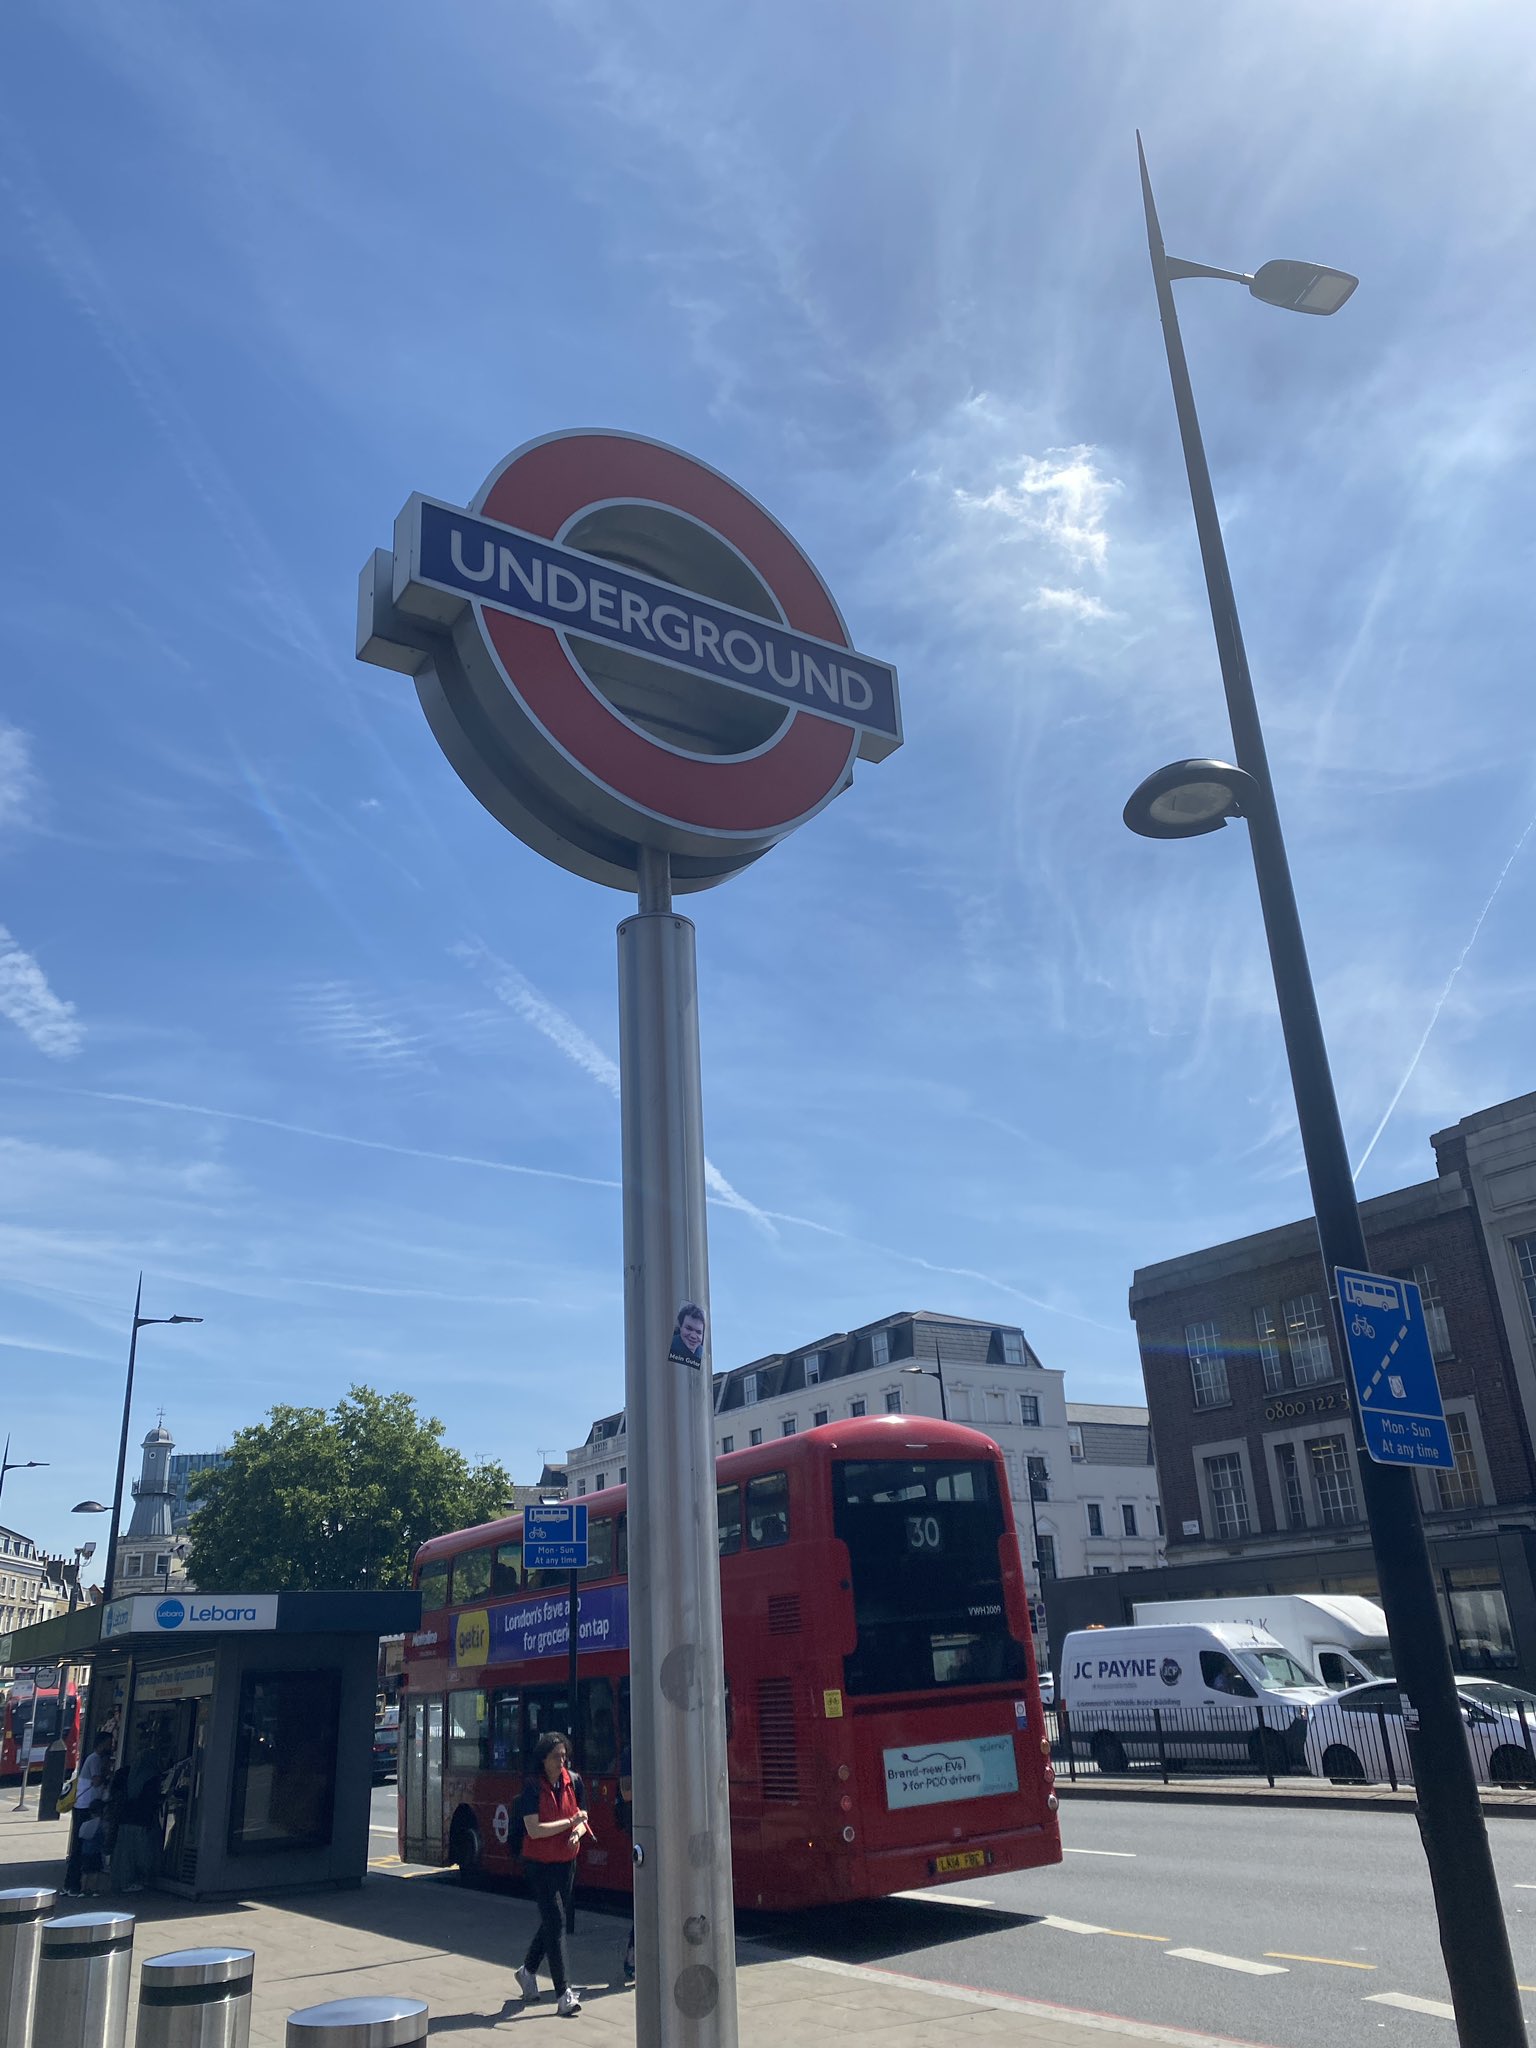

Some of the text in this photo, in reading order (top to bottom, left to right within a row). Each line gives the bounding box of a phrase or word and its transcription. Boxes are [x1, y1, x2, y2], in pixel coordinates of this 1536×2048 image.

[450, 529, 874, 712] UNDERGROUND
[1265, 1401, 1306, 1421] 0800
[1311, 1395, 1336, 1412] 122
[1382, 1439, 1439, 1459] At any time
[908, 1517, 940, 1547] 30
[534, 1556, 544, 1565] At
[561, 1556, 577, 1564] time
[158, 1609, 184, 1618] Lebara
[189, 1605, 256, 1622] Lebara
[504, 1605, 542, 1632] London's
[543, 1602, 564, 1620] fave
[458, 1624, 486, 1656] getir
[523, 1632, 536, 1651] for
[579, 1622, 592, 1639] on
[592, 1618, 610, 1641] tap
[1073, 1659, 1156, 1679] JC PAYNE
[887, 1761, 963, 1780] Brand-new EVs
[909, 1781, 924, 1791] for
